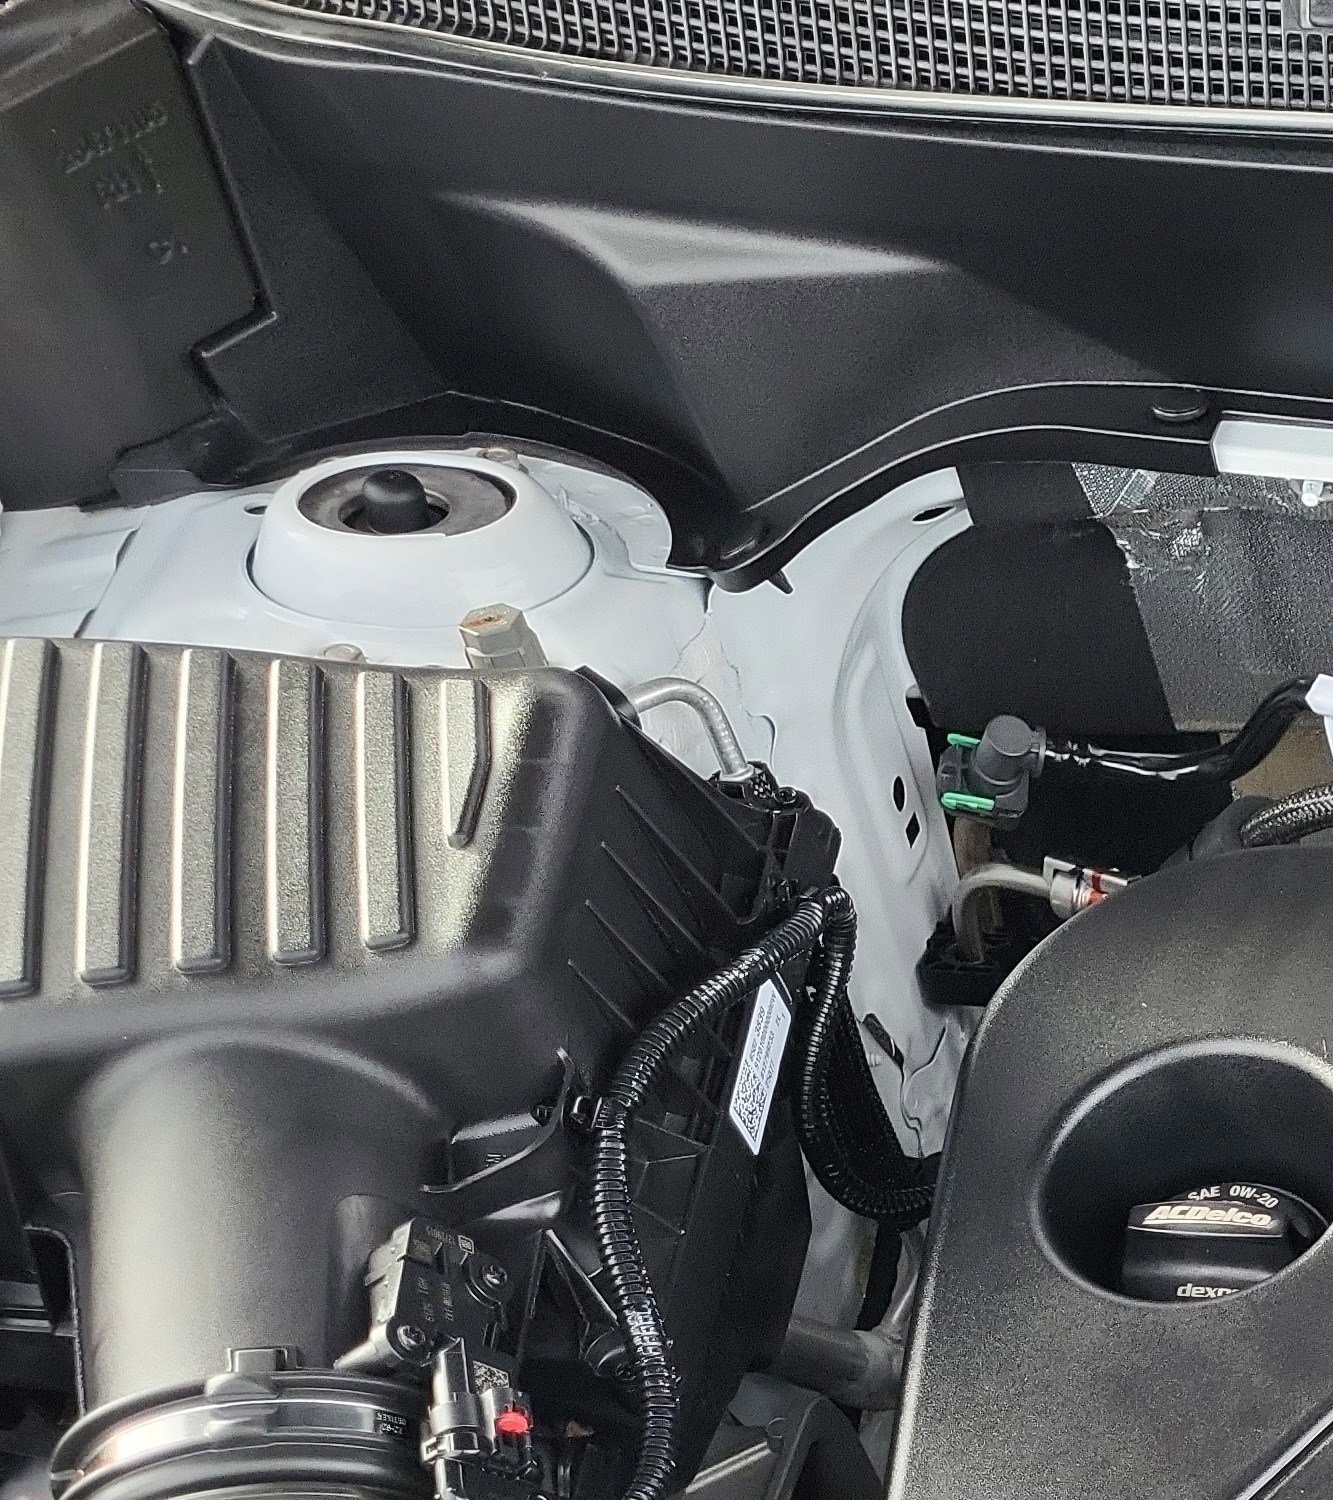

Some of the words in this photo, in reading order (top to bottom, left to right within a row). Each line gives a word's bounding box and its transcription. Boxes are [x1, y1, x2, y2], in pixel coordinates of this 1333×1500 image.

[1187, 1185, 1221, 1201] SAE
[1229, 1185, 1279, 1209] 0W-20
[1143, 1206, 1273, 1227] ACDelco
